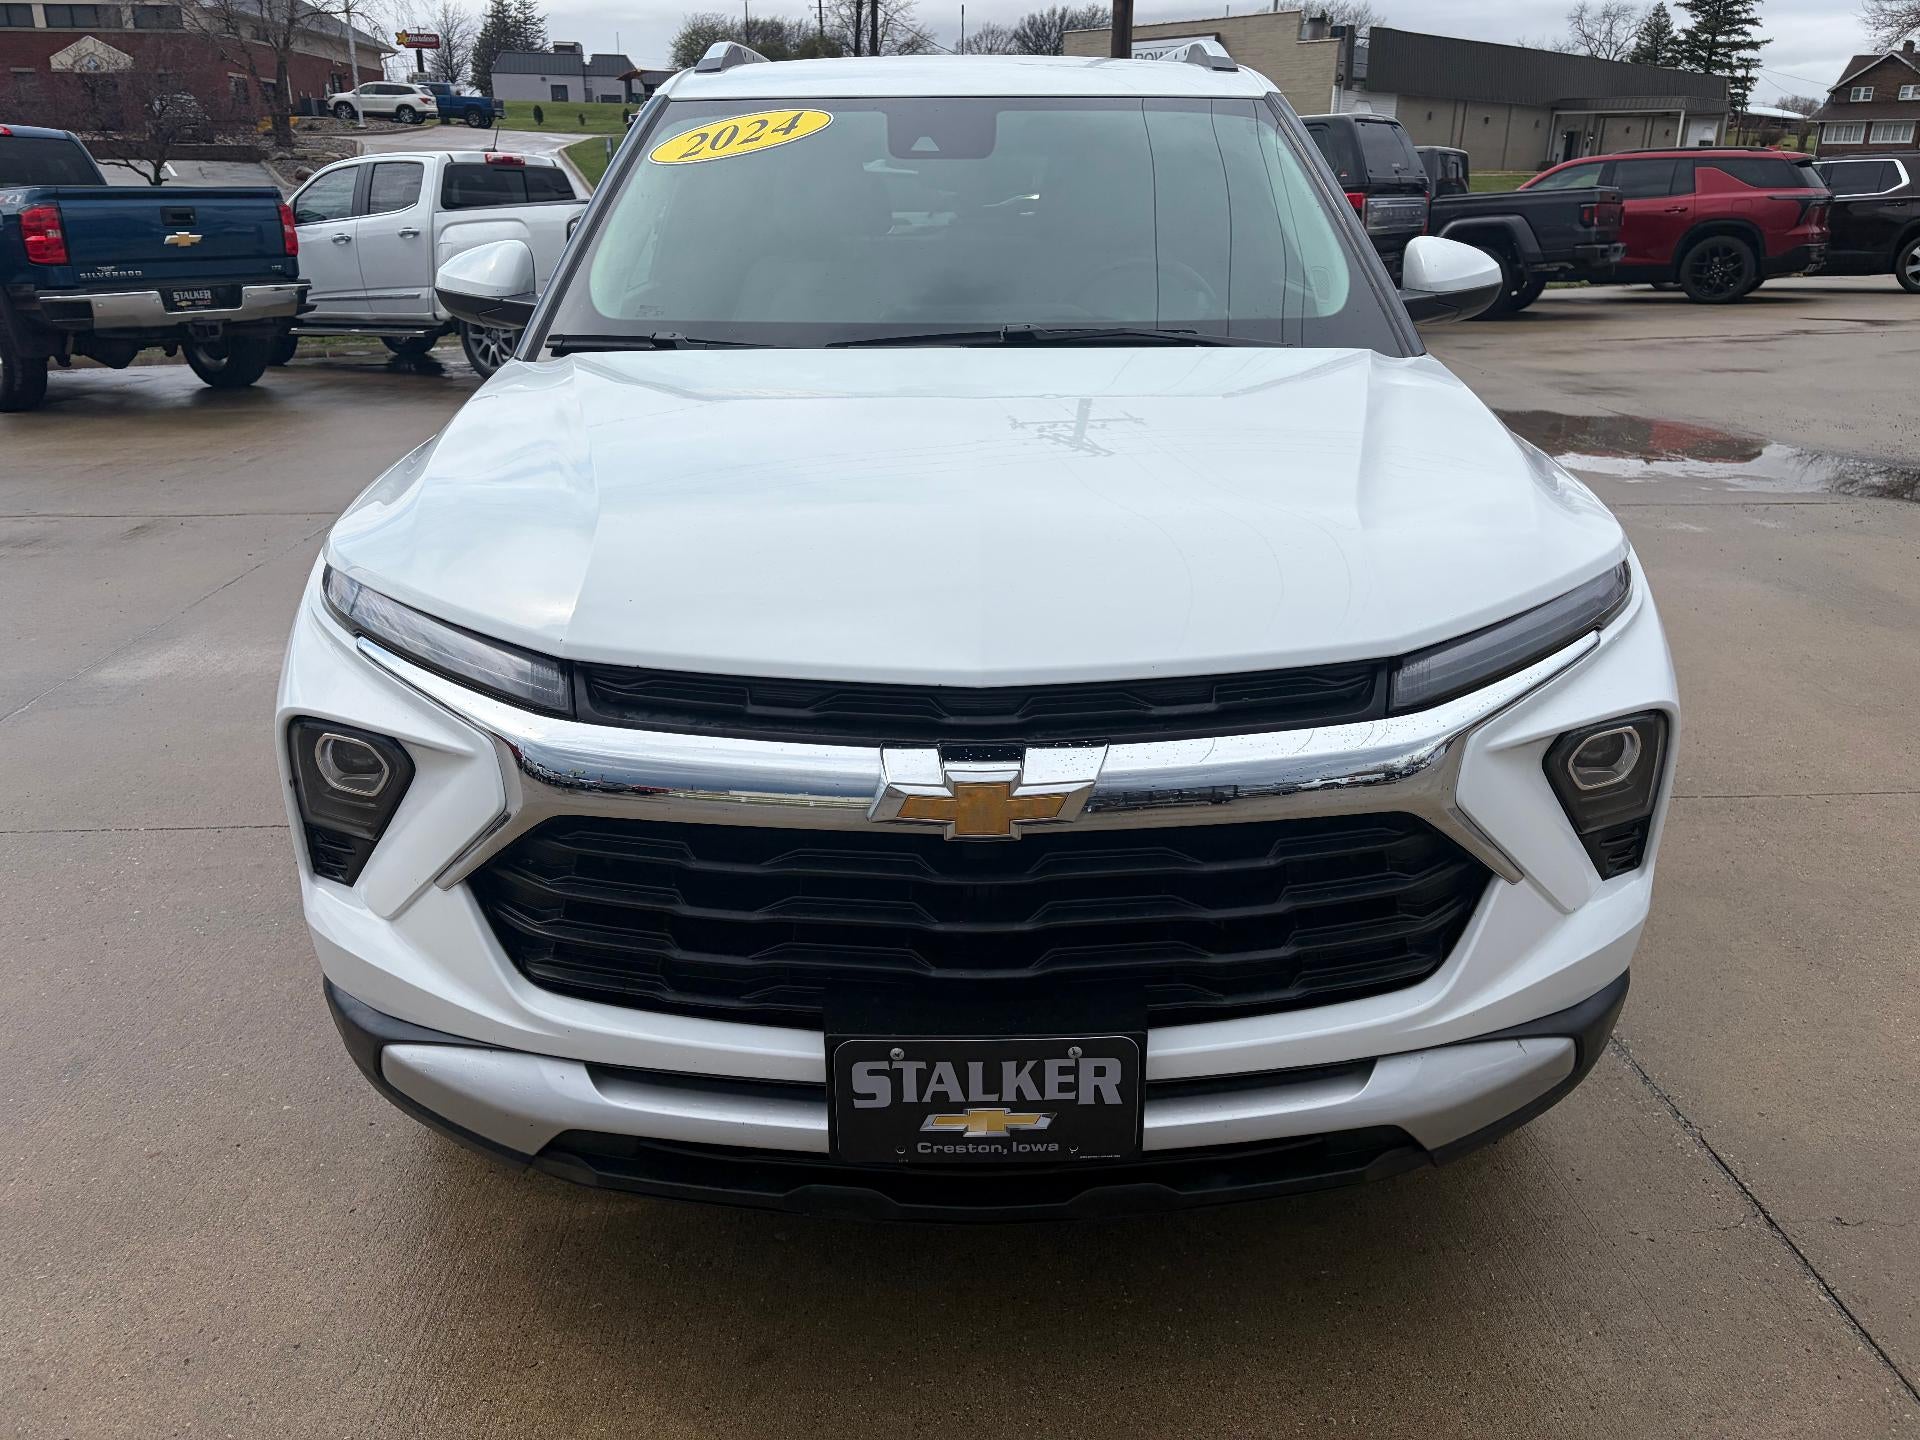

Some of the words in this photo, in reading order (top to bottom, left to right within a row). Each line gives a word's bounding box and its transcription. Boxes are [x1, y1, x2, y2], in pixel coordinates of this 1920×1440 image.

[678, 112, 804, 160] 2024
[79, 270, 142, 279] SILVERADO
[172, 289, 212, 302] STALKER
[851, 1056, 1123, 1109] STALKER
[917, 1142, 1008, 1155] Creston,
[1012, 1141, 1059, 1153] Iowa
